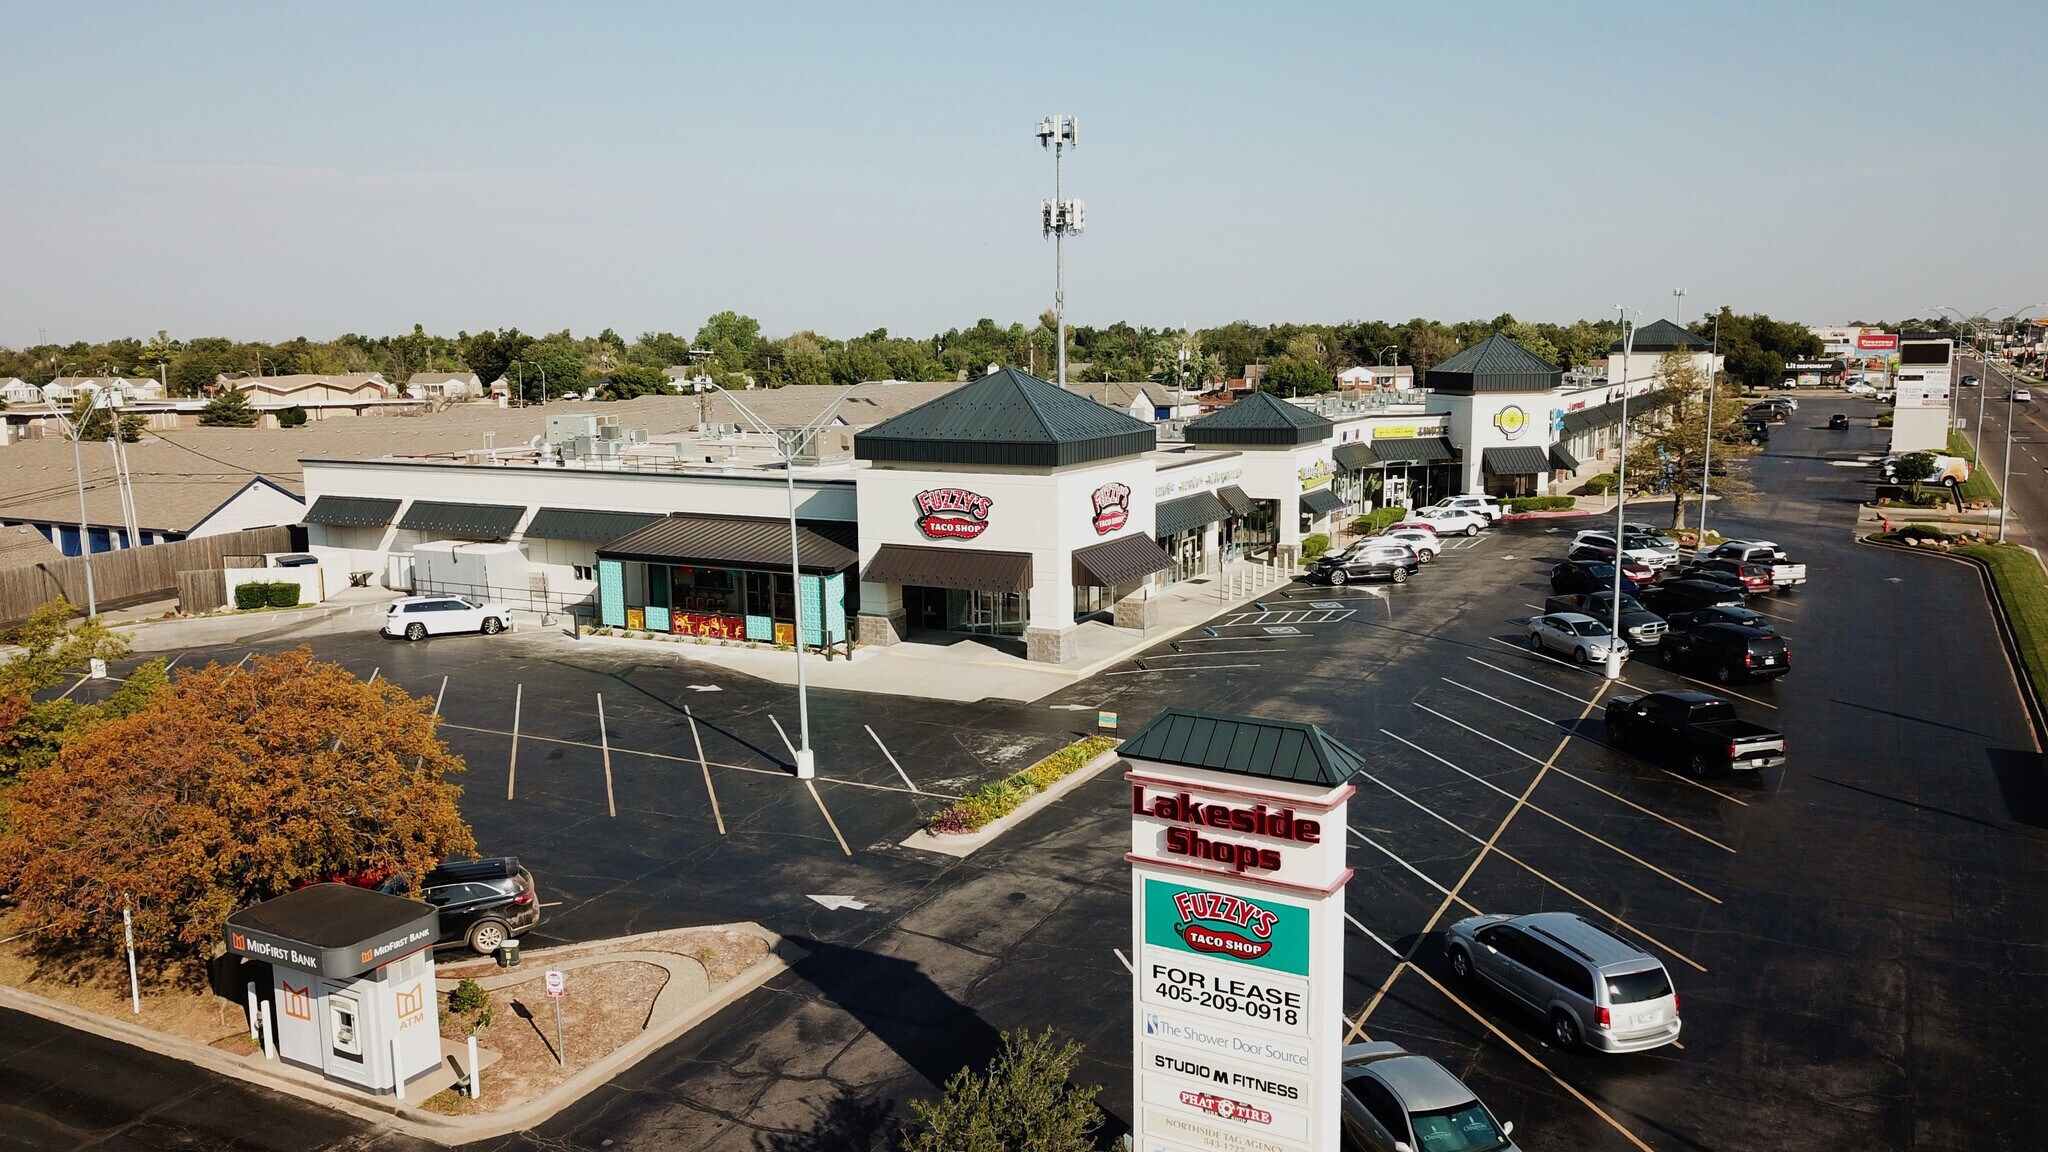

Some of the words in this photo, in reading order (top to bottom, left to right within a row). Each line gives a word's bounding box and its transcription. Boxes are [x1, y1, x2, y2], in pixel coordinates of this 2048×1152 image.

[917, 489, 991, 519] FUZZY'S
[1092, 484, 1130, 515] FUZZY'S
[930, 523, 954, 531] TACO
[955, 524, 981, 532] SHOP
[1133, 784, 1321, 844] Lakeside
[1166, 825, 1282, 872] Shops
[1173, 890, 1279, 938] FUZZY'S
[409, 928, 430, 942] BANK
[1190, 932, 1223, 947] TACO
[1225, 939, 1262, 955] SHOP
[290, 950, 317, 969] BANK
[1152, 964, 1206, 989] FOR
[1214, 977, 1301, 1009] LEASE
[1155, 982, 1298, 1026] 405-209-0918
[399, 1012, 424, 1031] ATM
[1159, 1020, 1181, 1037] The
[1183, 1026, 1229, 1048] Shower
[1232, 1037, 1263, 1055] Door
[1265, 1044, 1307, 1066] Source
[1155, 1054, 1210, 1079] STUDIO
[1213, 1069, 1229, 1085] M
[1233, 1073, 1299, 1100] FITNESS
[1181, 1092, 1215, 1109] PHAT
[1236, 1106, 1270, 1124] TIRE
[1165, 1118, 1220, 1139] NORTHSIDE
[1223, 1133, 1242, 1144] TAG
[1244, 1138, 1285, 1152] AGENCY
